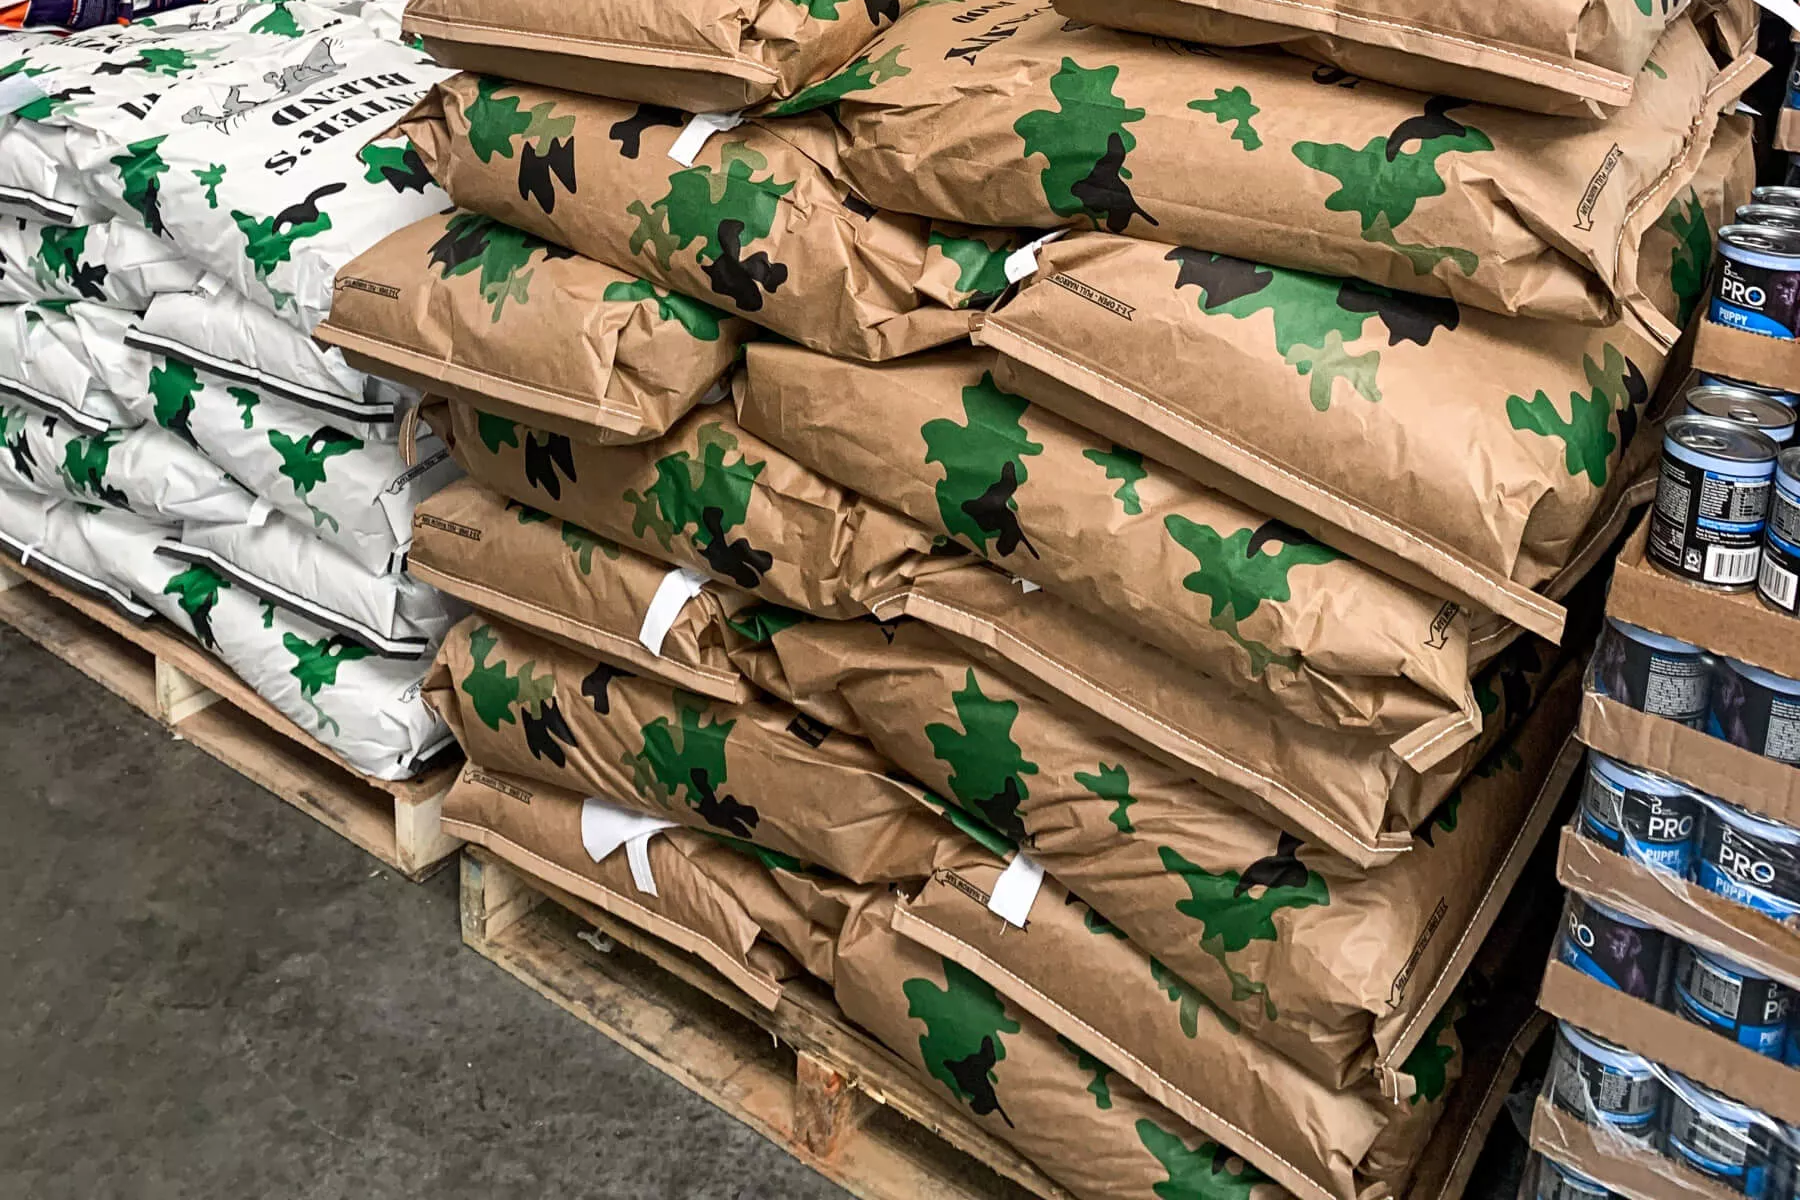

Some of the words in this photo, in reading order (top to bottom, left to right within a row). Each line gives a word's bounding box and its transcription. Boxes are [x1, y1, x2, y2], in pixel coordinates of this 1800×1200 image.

[272, 73, 416, 126] BLEND
[1078, 285, 1094, 298] PULL
[1097, 294, 1116, 308] OPEN
[1721, 277, 1766, 306] PRO
[1719, 307, 1748, 326] PUPPY
[1648, 815, 1693, 839] PRO
[1719, 845, 1776, 884] PRO
[1568, 911, 1595, 947] RO
